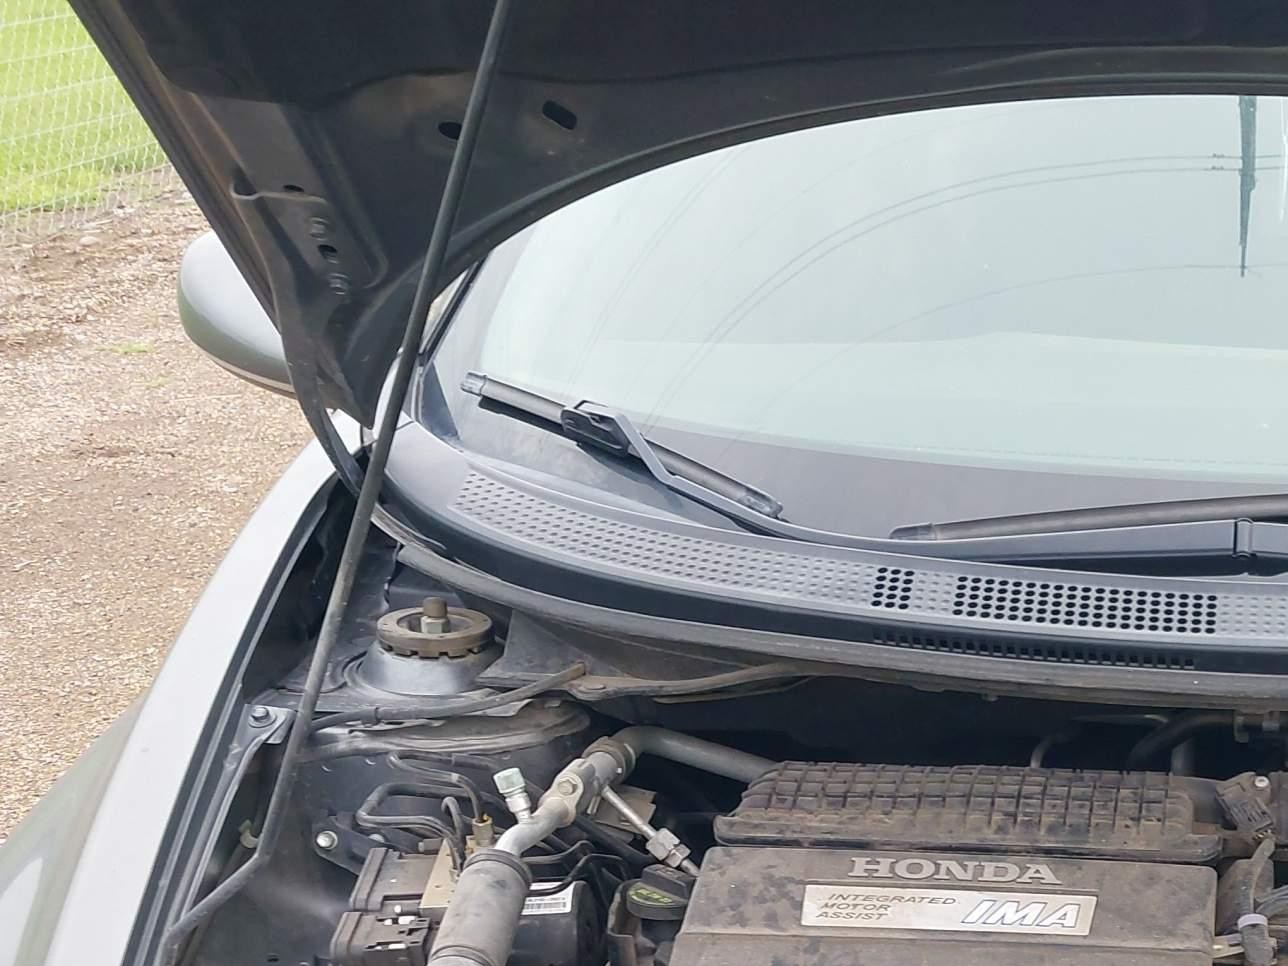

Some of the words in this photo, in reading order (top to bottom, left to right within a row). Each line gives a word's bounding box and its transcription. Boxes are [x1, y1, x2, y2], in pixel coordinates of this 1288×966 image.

[848, 857, 1063, 885] HONDA
[828, 893, 958, 905] INTEGRATED
[820, 902, 892, 911] MOTOR
[816, 911, 890, 921] ASSIST
[961, 899, 1081, 929] IMA
